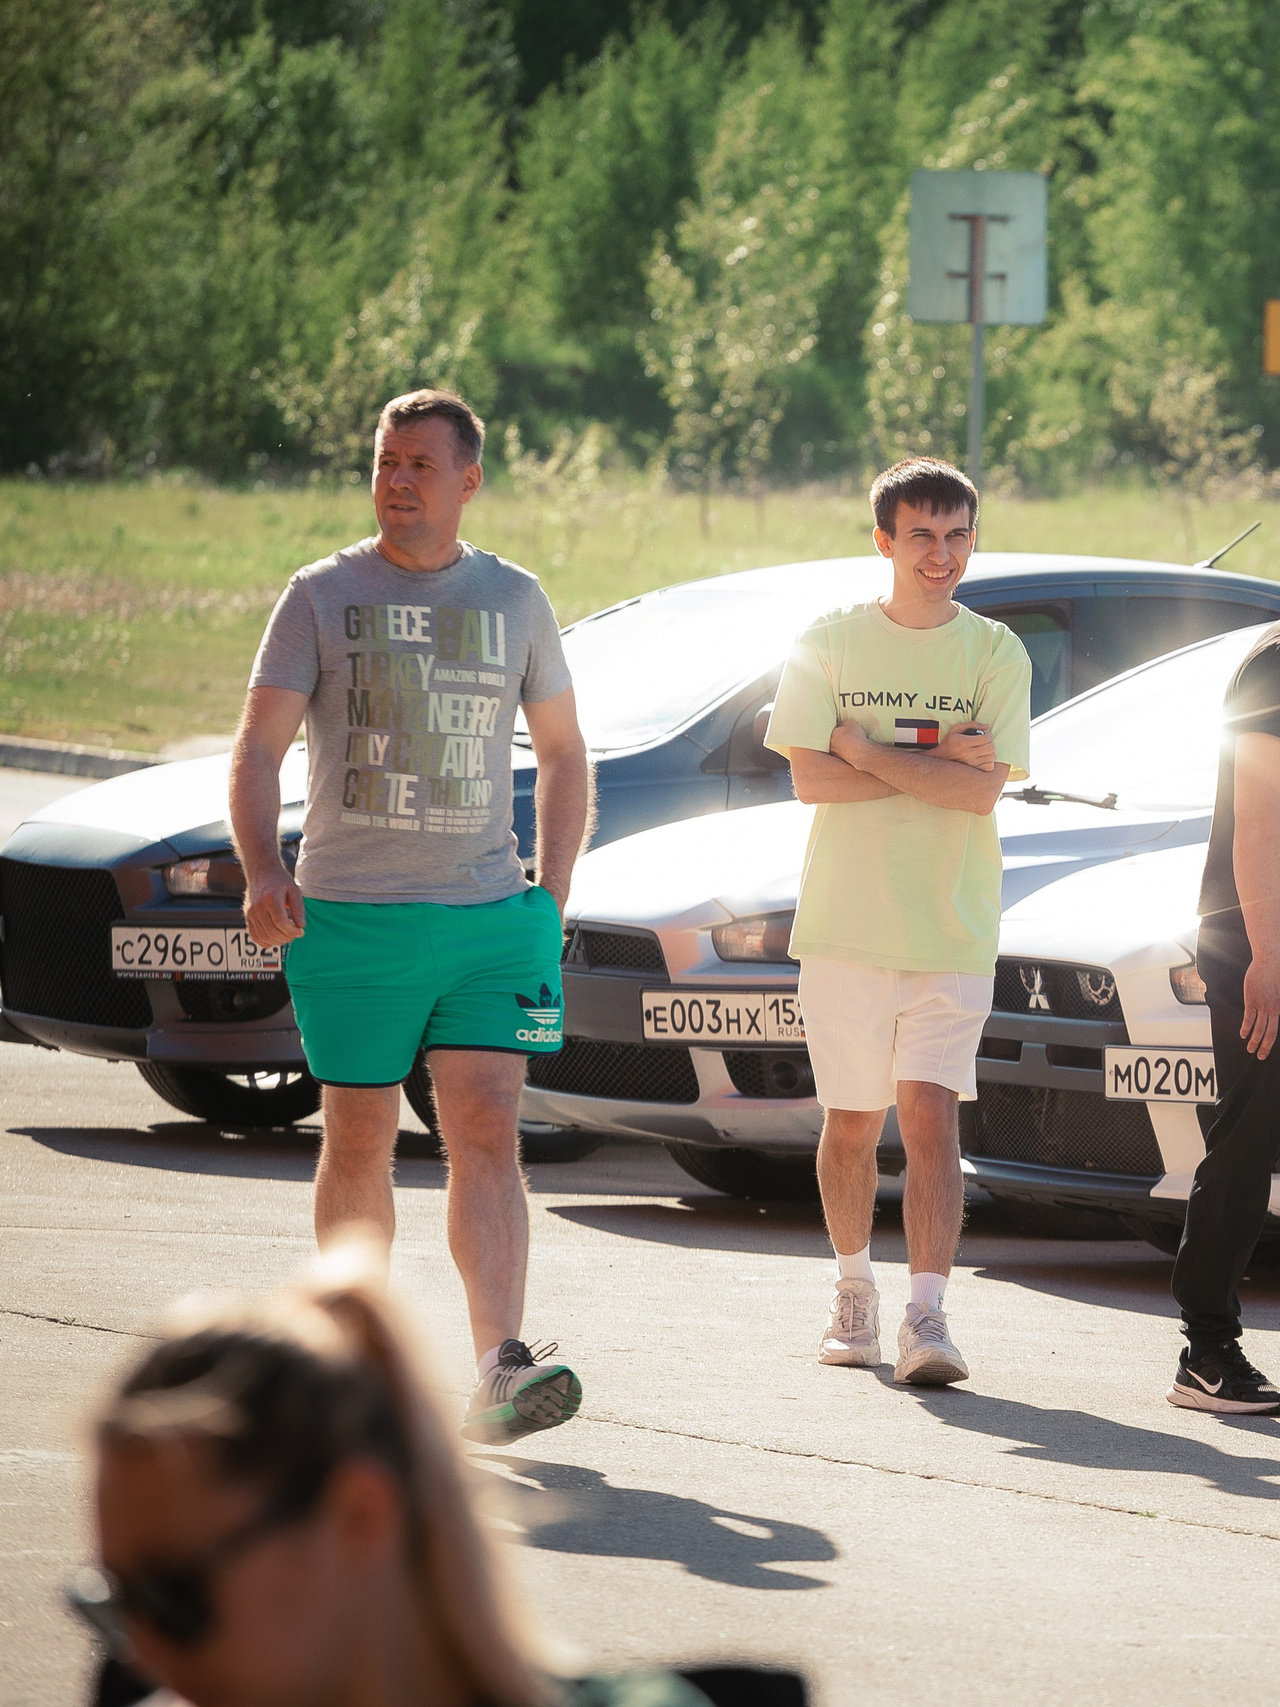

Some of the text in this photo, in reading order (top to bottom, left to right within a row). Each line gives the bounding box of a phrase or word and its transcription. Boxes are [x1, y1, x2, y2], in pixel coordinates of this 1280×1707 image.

[344, 604, 507, 667] GREECE BALI
[346, 651, 436, 691] TURKEY
[434, 668, 507, 687] AMAZING WORLD
[839, 691, 975, 714] TOMMY JEAN
[394, 731, 487, 779] CROATIA
[341, 767, 494, 816] CRETE THAILAND
[388, 817, 421, 831] WORLD
[241, 957, 262, 968] RUS
[515, 1027, 562, 1043] adidas
[777, 1027, 800, 1037] RUS
